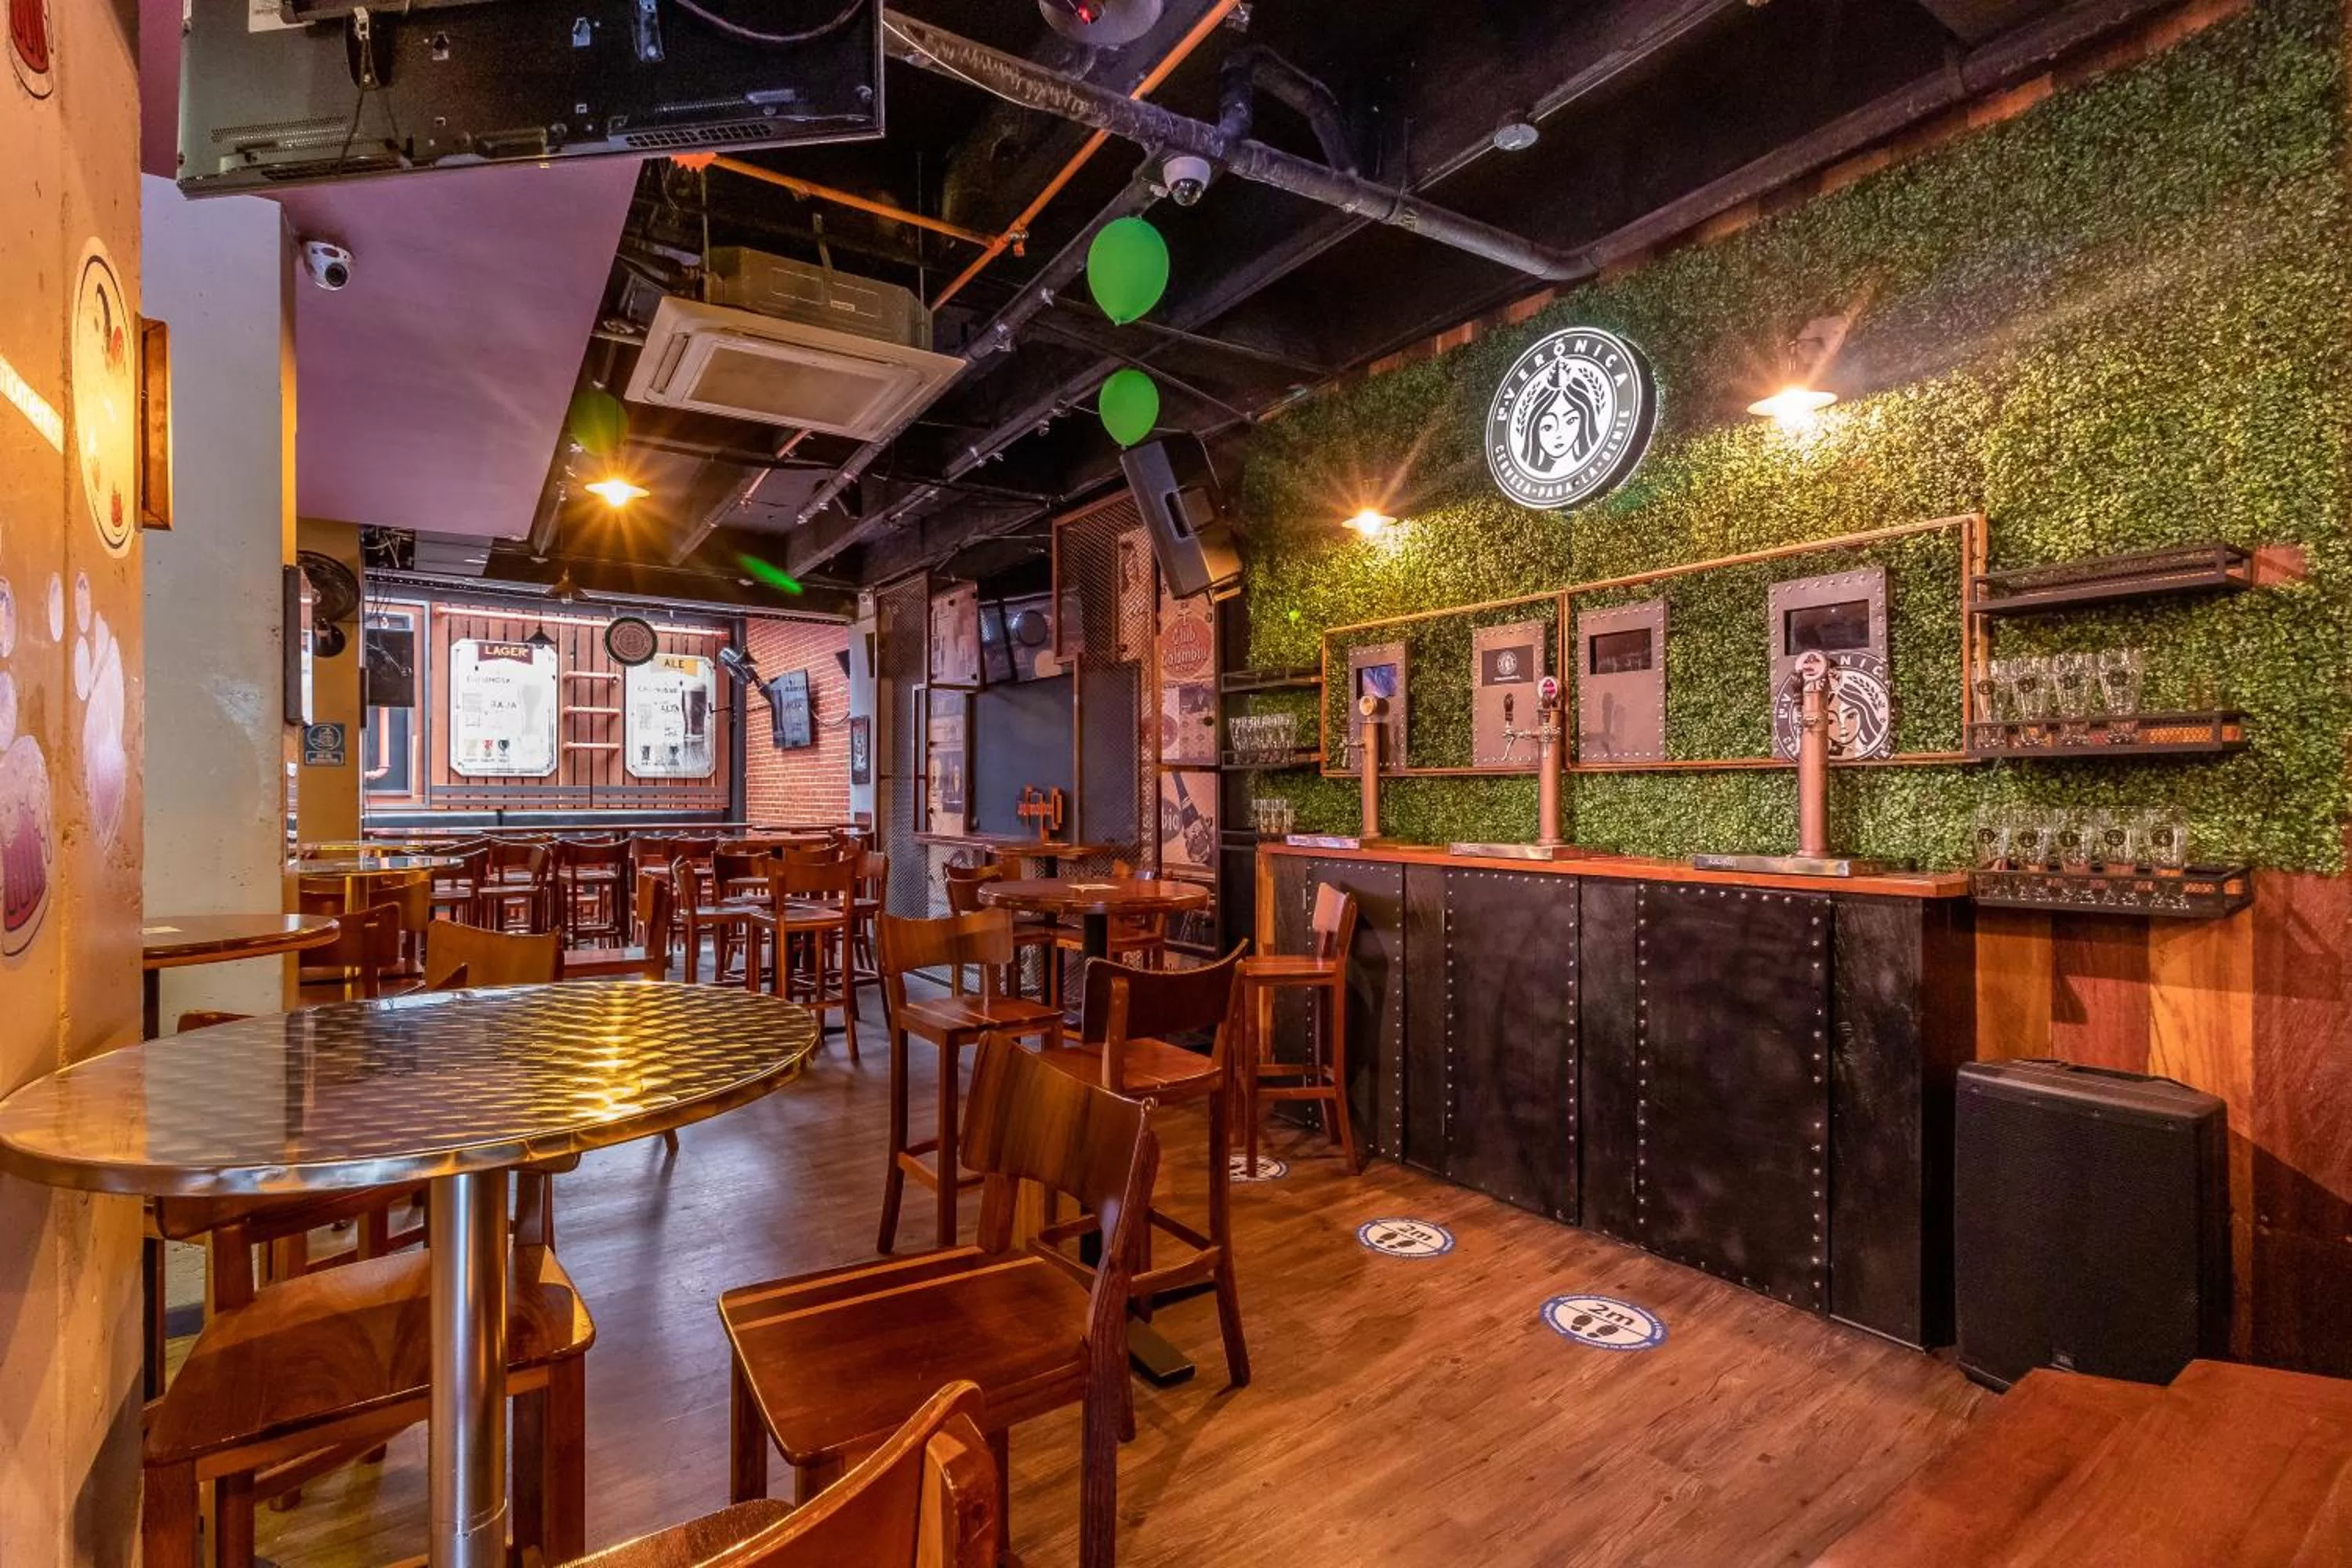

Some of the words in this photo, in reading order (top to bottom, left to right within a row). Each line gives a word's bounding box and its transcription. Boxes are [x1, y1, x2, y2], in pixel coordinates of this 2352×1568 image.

[485, 645, 528, 658] LAGER
[664, 659, 684, 669] ALE
[1397, 1224, 1433, 1241] 2m
[1587, 1303, 1635, 1326] 2m
